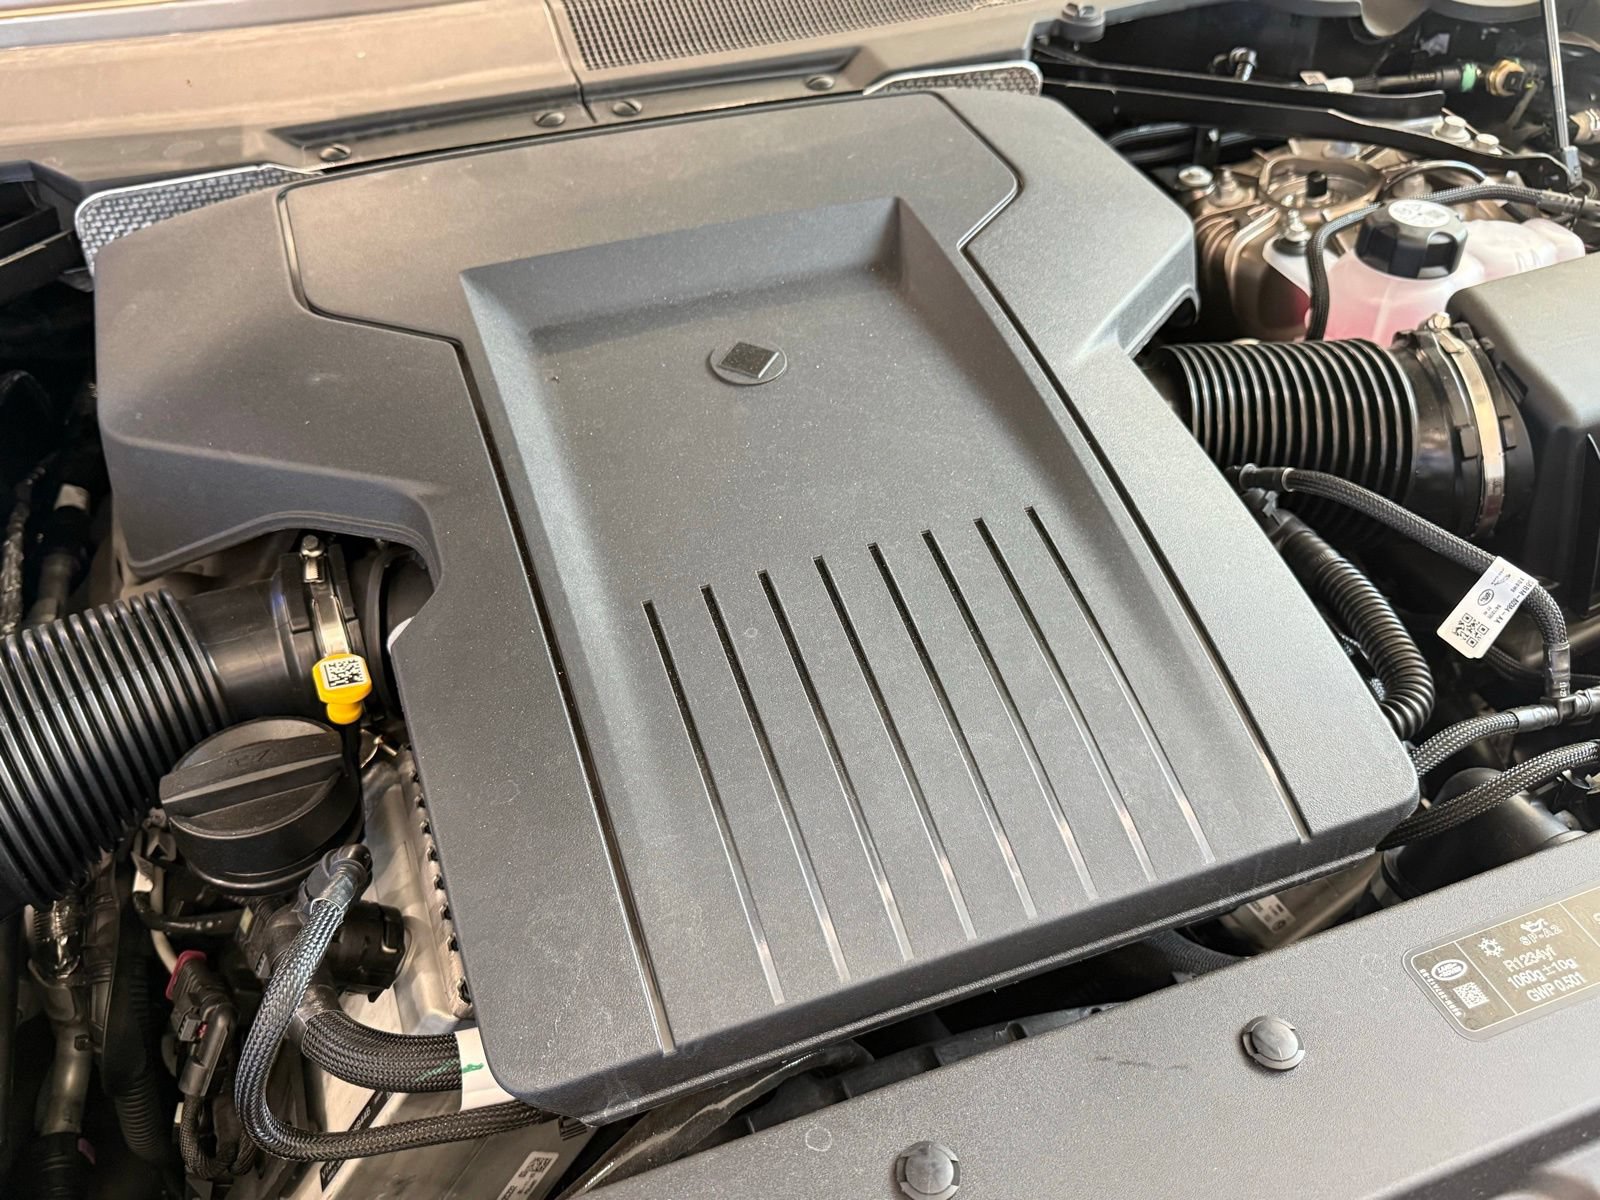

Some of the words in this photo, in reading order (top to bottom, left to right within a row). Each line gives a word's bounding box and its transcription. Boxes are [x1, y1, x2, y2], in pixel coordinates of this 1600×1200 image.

[1503, 944, 1557, 972] R1234yf
[1507, 969, 1547, 990] 1060g
[1526, 983, 1558, 1002] GWP
[1556, 971, 1586, 993] 0.501
